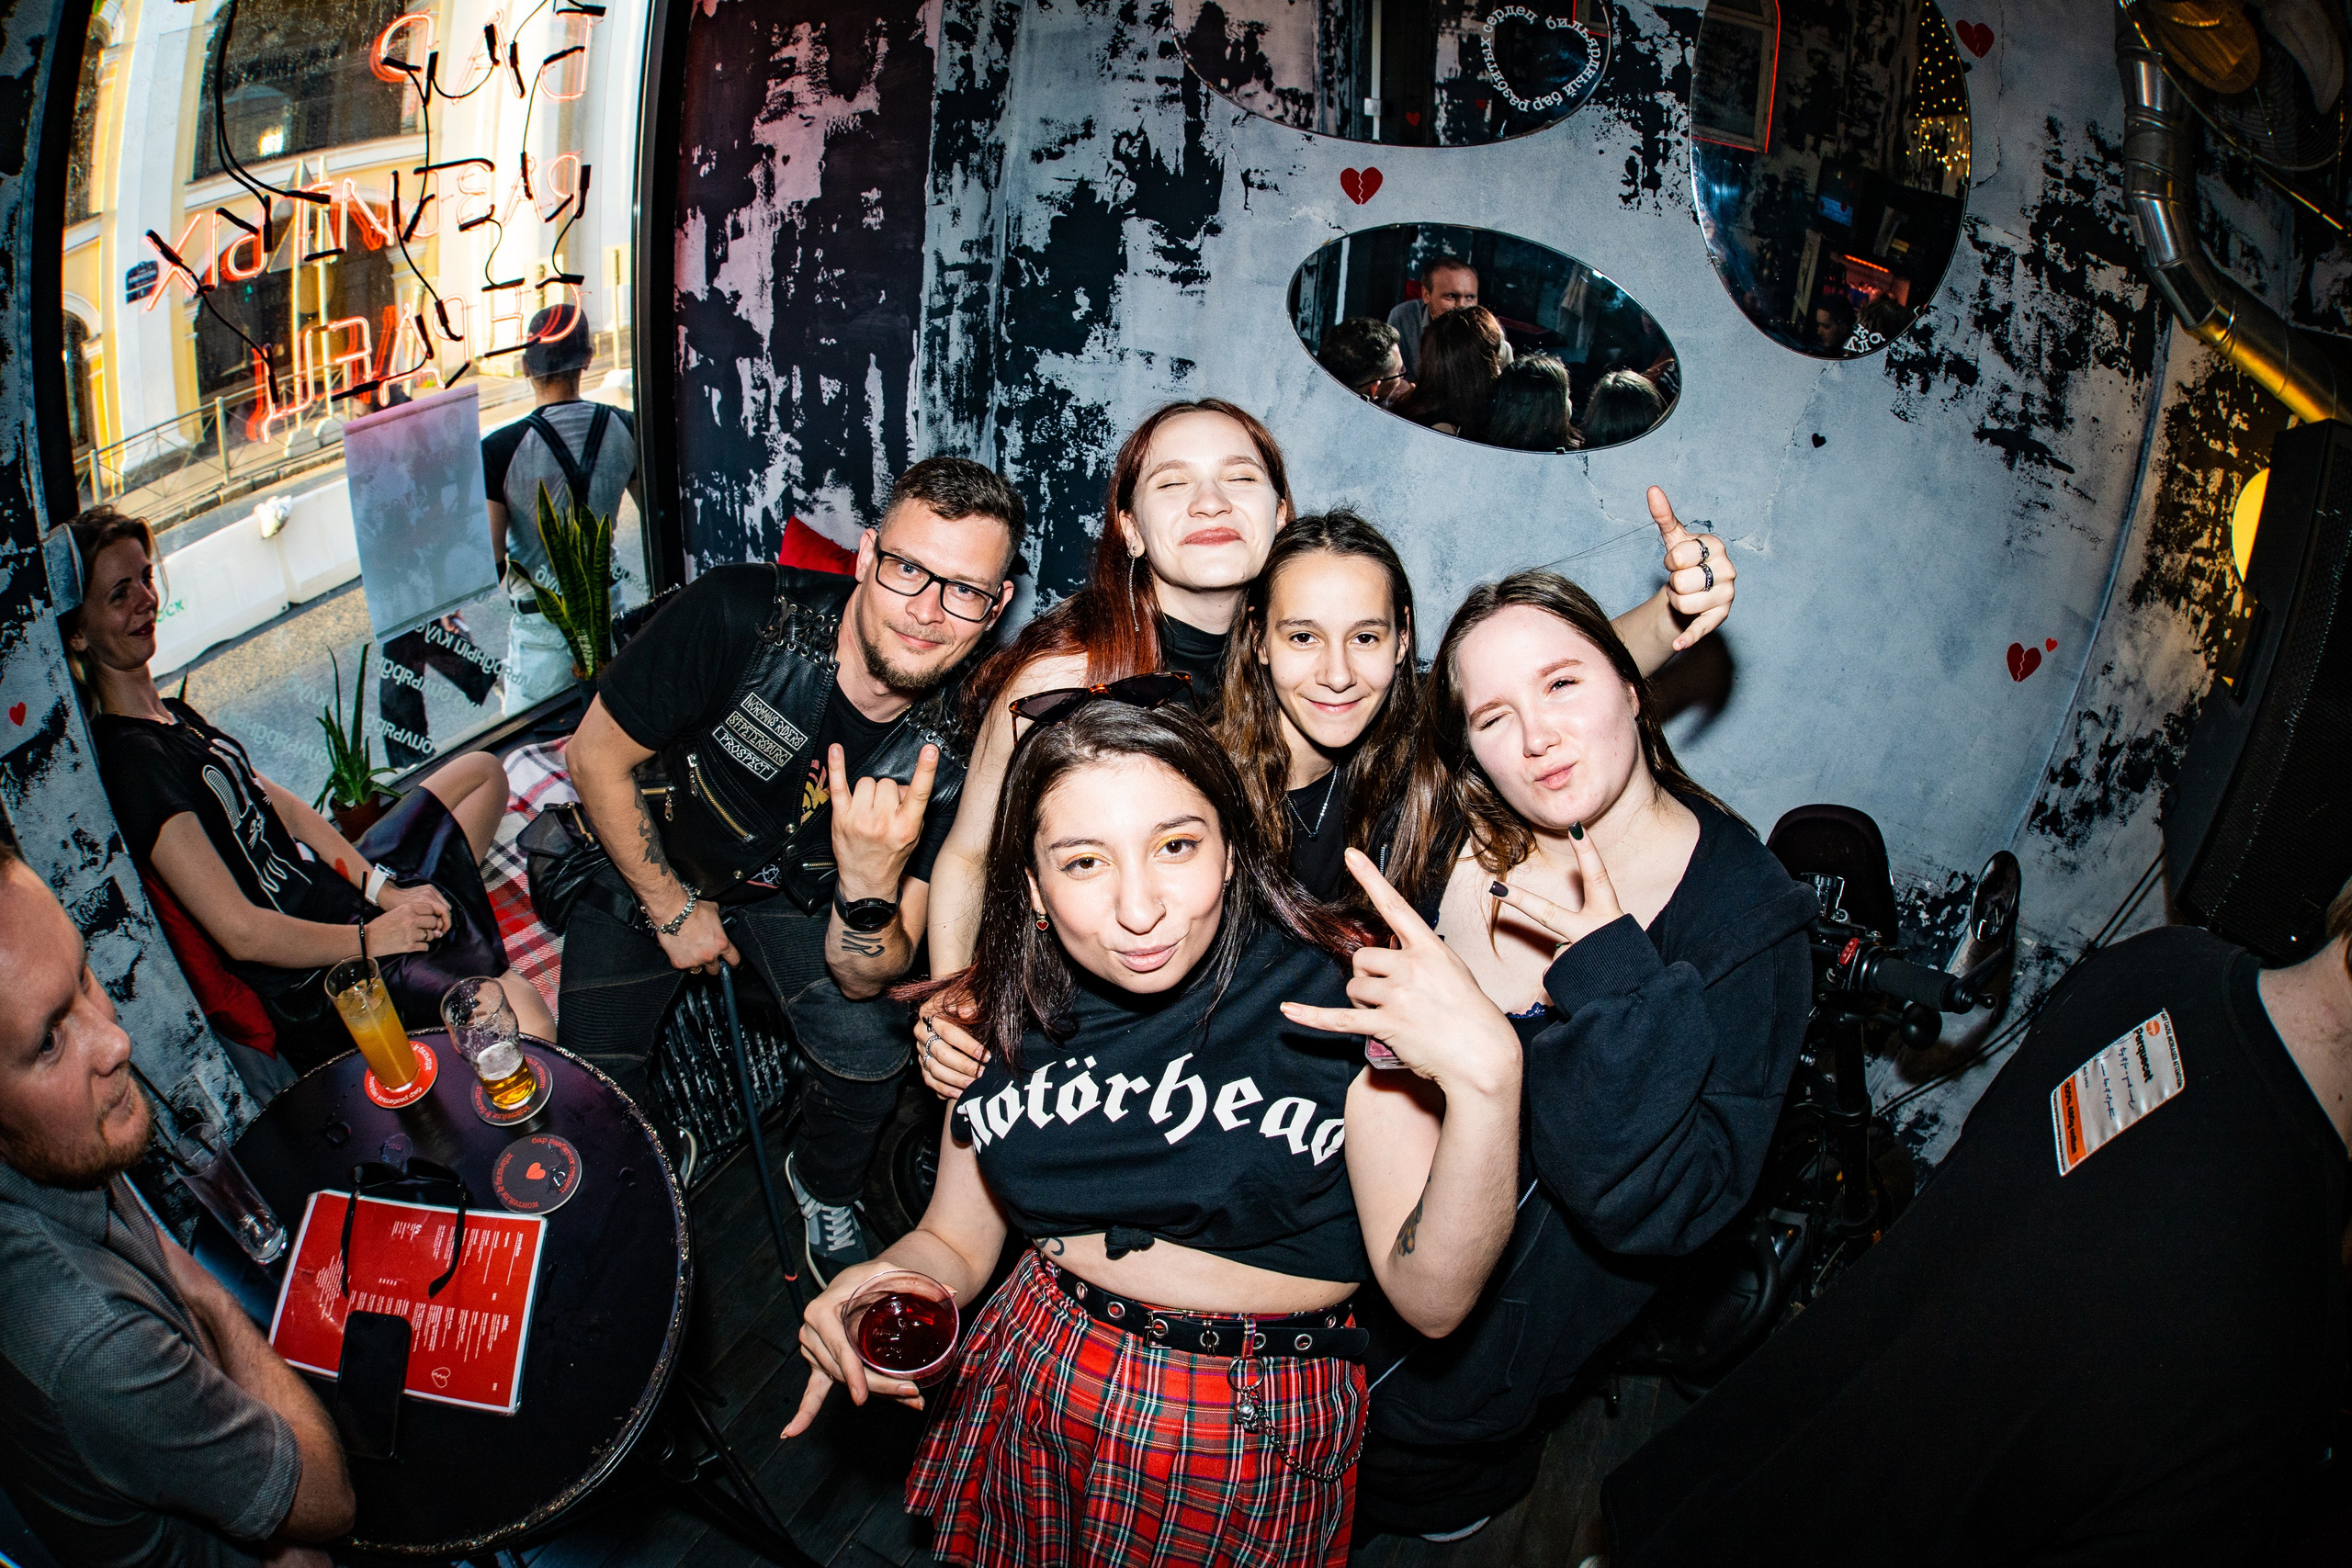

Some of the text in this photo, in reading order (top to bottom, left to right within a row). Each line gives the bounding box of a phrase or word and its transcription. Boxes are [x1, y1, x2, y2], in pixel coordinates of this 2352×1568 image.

[1481, 5, 1601, 112] бильярдный бар разбитых сердец
[744, 695, 804, 748] NORMANS RIDERS
[719, 731, 770, 775] PROSPECT
[2132, 1026, 2154, 1083] Perquecet
[2172, 1059, 2183, 1089] ATTENTION
[2064, 1082, 2073, 1106] 100%
[2069, 1127, 2077, 1154] cotton
